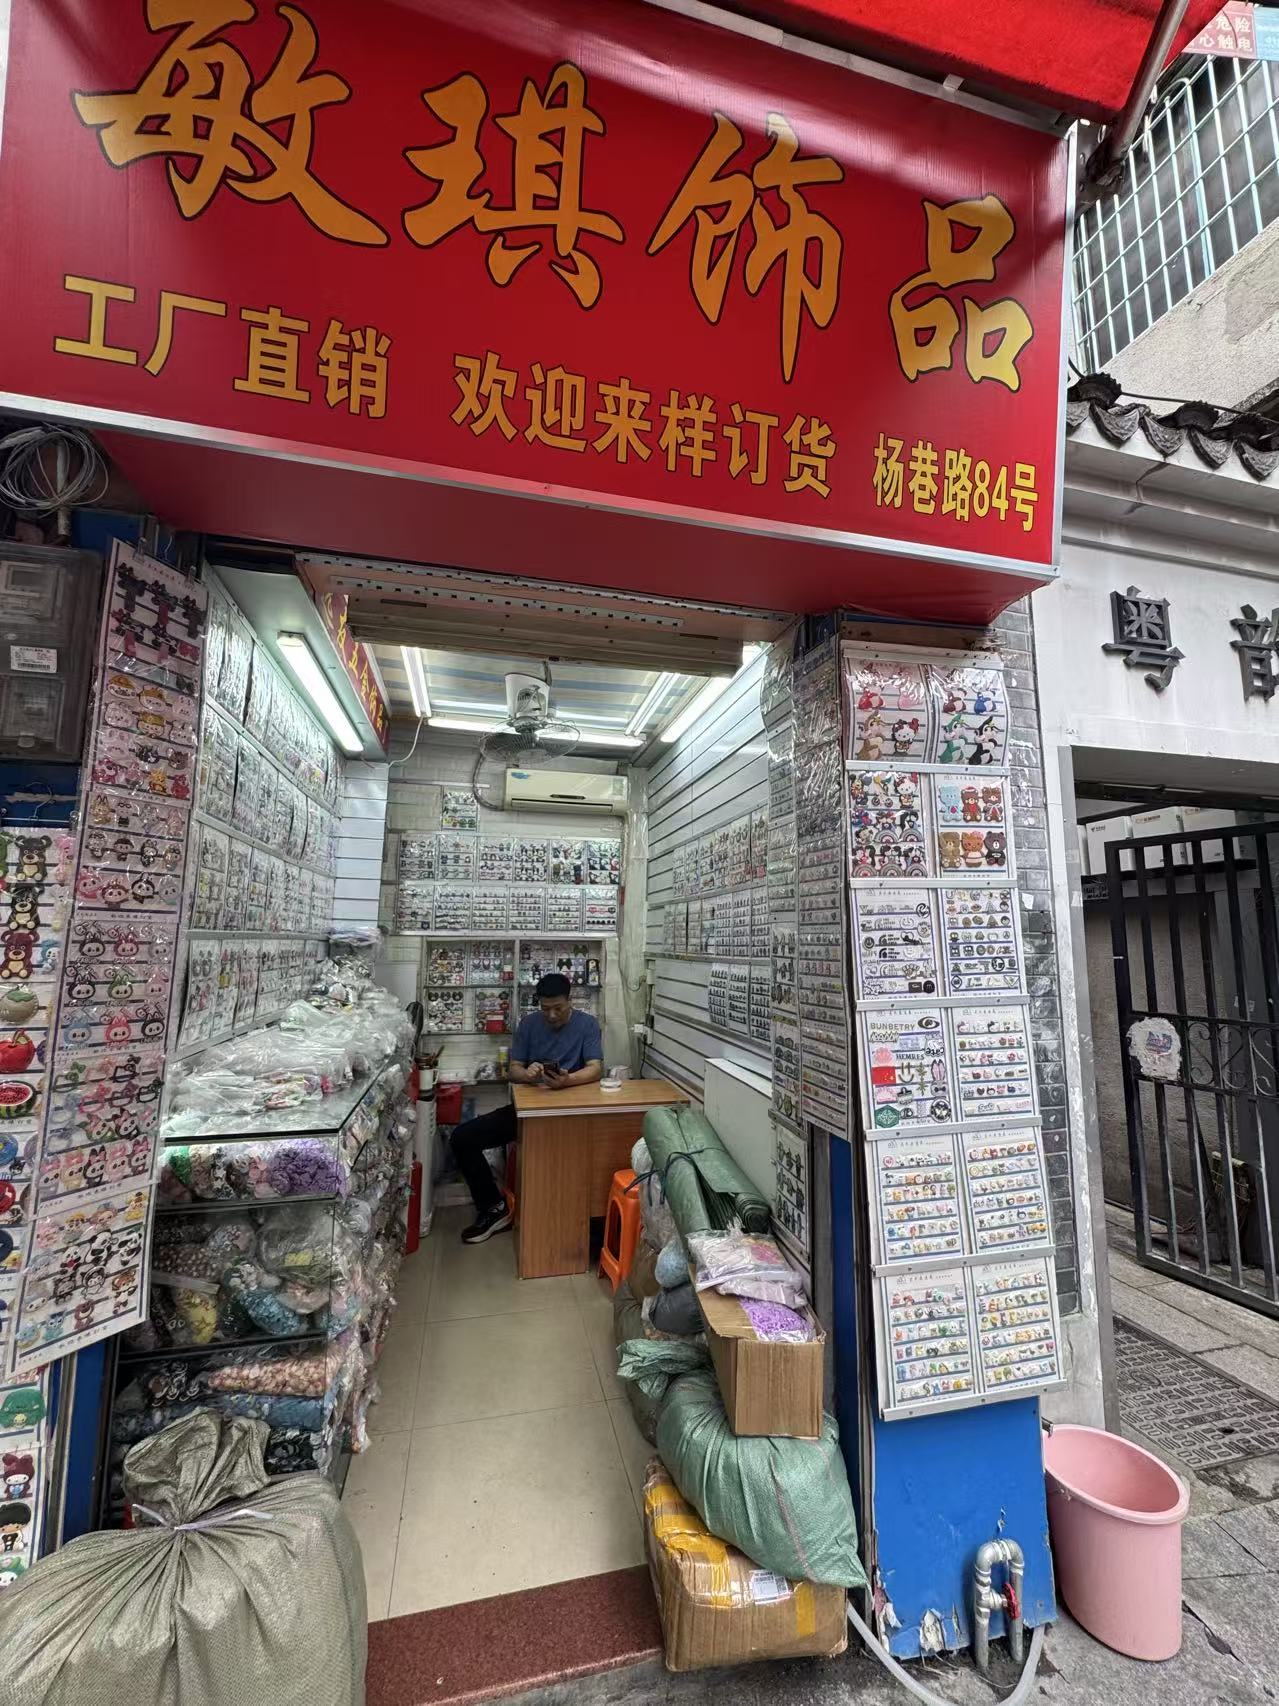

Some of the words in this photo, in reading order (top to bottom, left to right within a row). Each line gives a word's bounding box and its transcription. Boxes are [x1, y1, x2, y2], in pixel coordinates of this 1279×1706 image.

[1189, 34, 1252, 52] 心触电
[1206, 15, 1251, 32] 危险
[73, 0, 1033, 391] 敏琪饰品
[53, 274, 392, 418] 工厂直销
[451, 351, 837, 498] 欢迎来样订货
[873, 433, 1039, 532] 杨巷路84号
